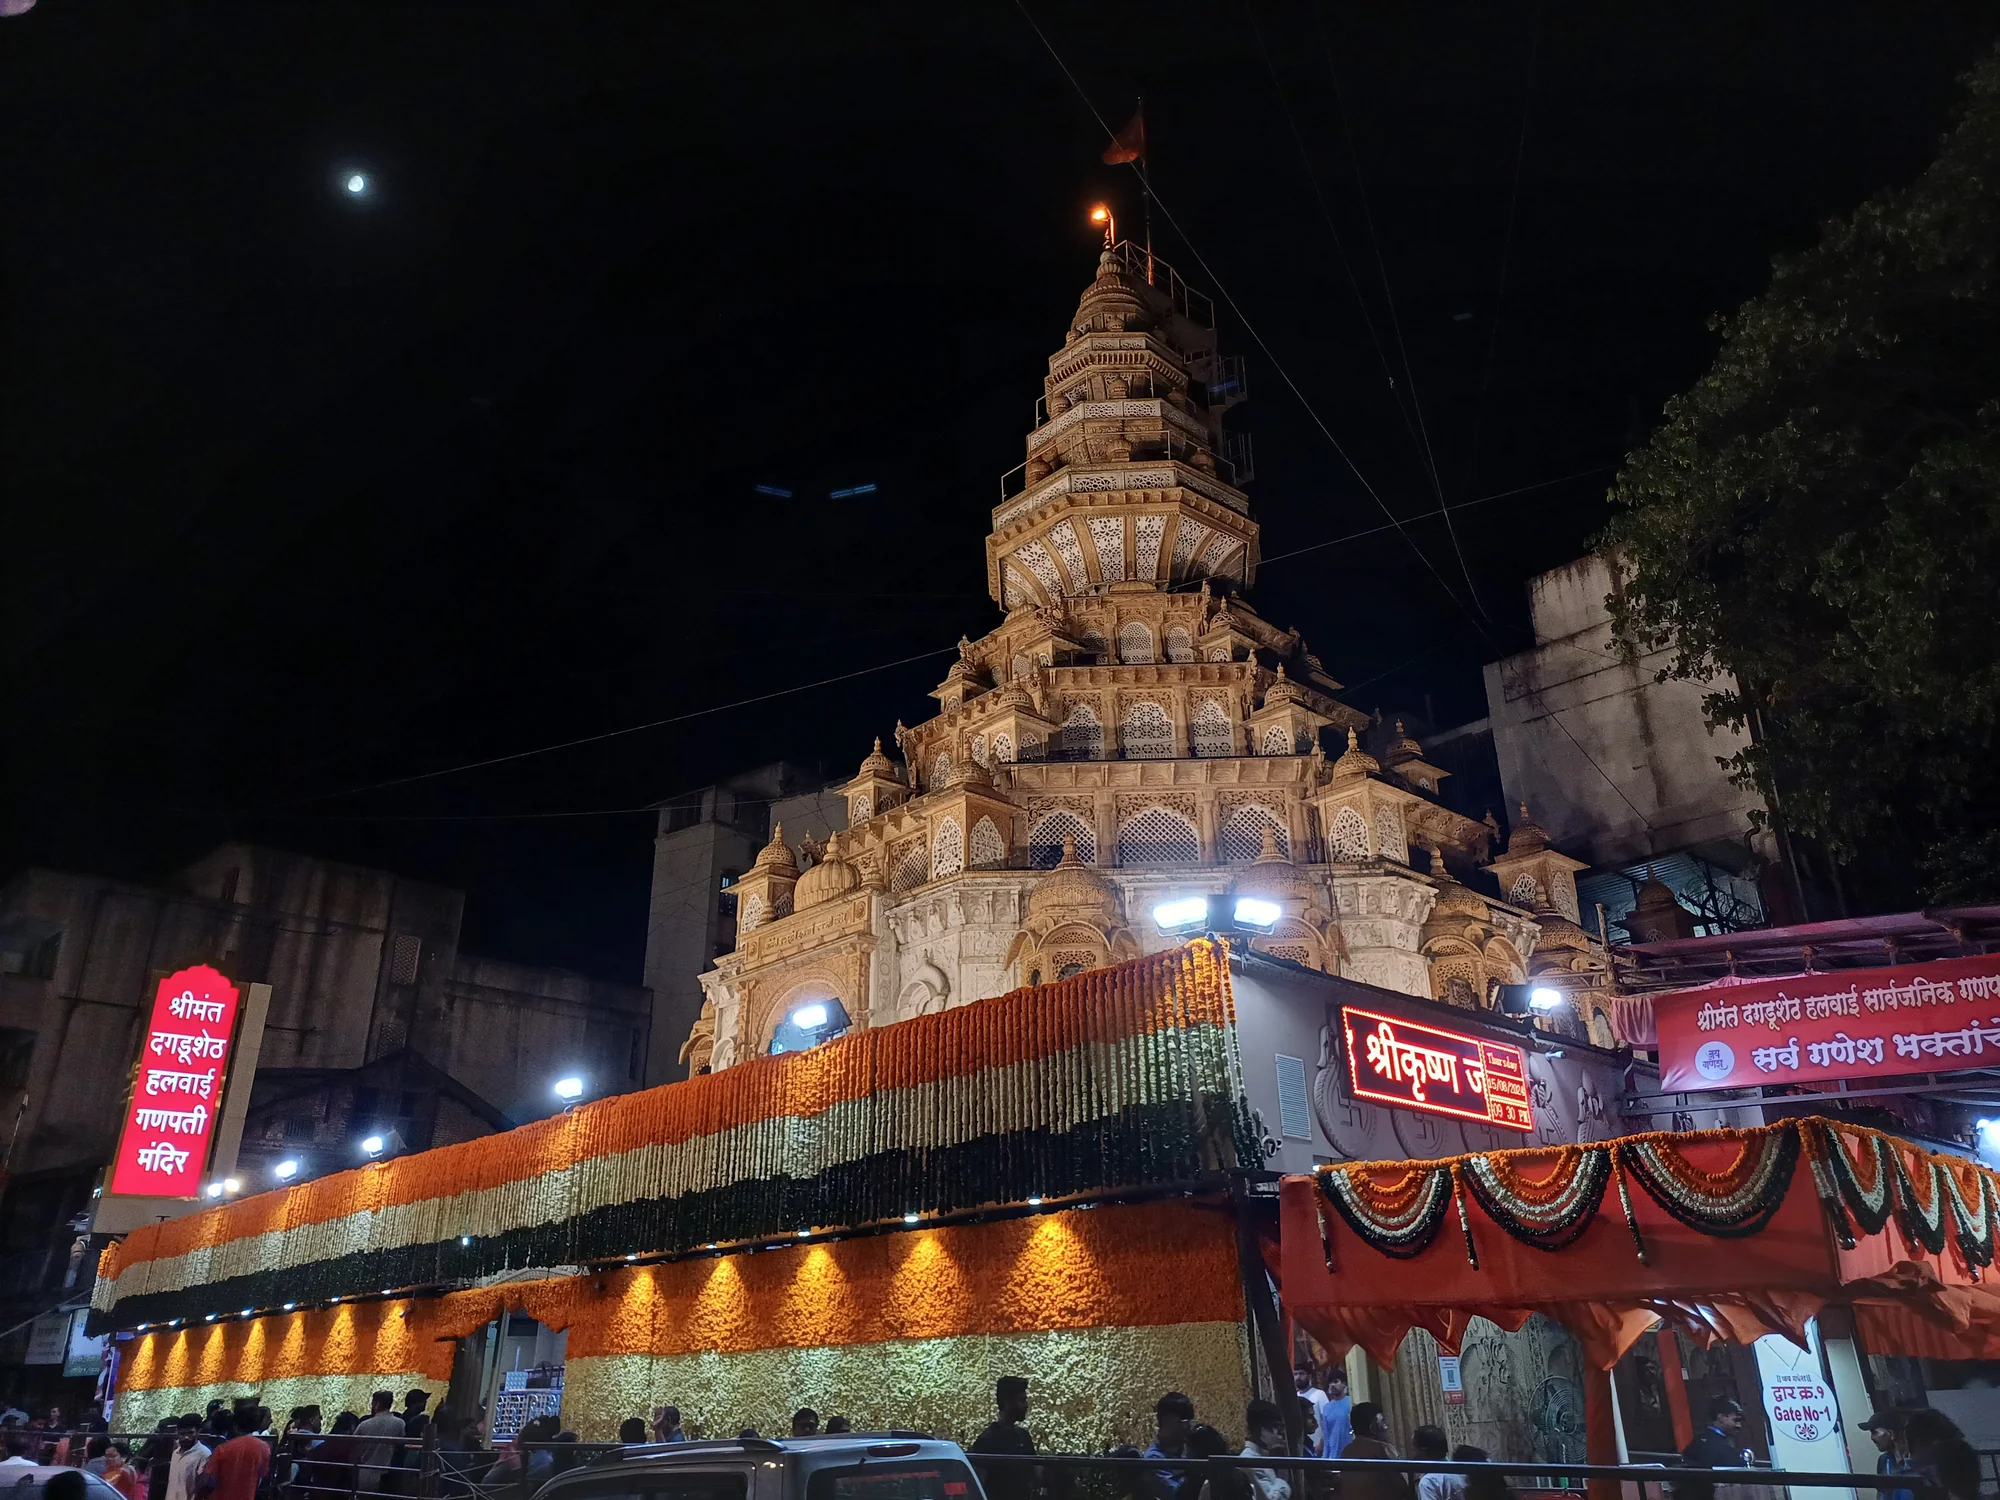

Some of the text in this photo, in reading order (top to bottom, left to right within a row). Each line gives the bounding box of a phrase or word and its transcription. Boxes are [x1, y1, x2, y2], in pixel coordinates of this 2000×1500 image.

[168, 990, 225, 1023] श्रीमंत
[1697, 1000, 1739, 1031] श्रीमंत
[1741, 992, 1801, 1031] दगडूशेठ
[1804, 984, 1860, 1019] हलवाई
[1862, 979, 1955, 1013] सार्वजनिक
[150, 1029, 227, 1065] दगडूशेठ
[1366, 1021, 1460, 1101] श्रीकृष्ण
[1486, 1052, 1518, 1072] Thursday
[1752, 1037, 1799, 1073] सर्व
[1807, 1033, 1884, 1067] गणेश
[145, 1068, 216, 1099] हलवाई
[1488, 1078, 1526, 1096] 15/08/2024
[135, 1105, 208, 1135] गणपती
[1506, 1106, 1516, 1120] 30
[137, 1142, 189, 1175] मंदिर
[1771, 1386, 1797, 1402] द्वार
[1774, 1405, 1831, 1421] Gate No-1
